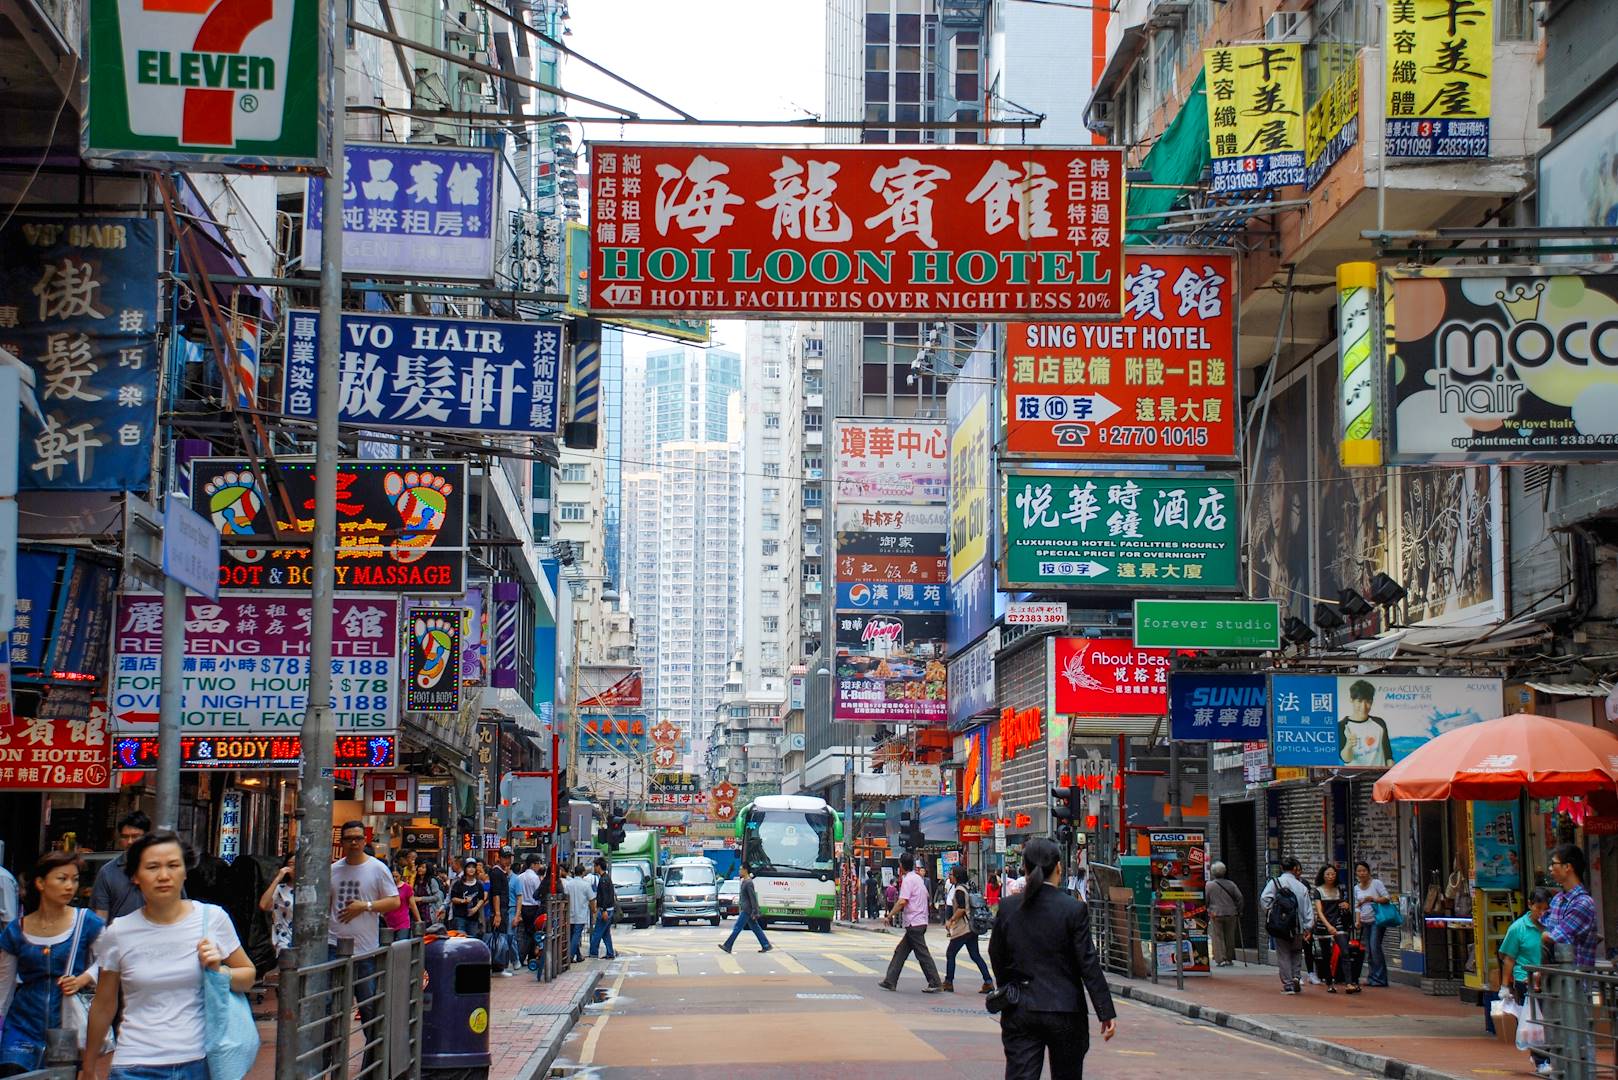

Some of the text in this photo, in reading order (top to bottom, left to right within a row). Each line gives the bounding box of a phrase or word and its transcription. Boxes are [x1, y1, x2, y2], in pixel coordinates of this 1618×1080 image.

[1391, 0, 1416, 116] 美容纖體
[1419, 0, 1488, 116] 卡美屋
[1211, 50, 1239, 155] 美容纖體
[1238, 47, 1300, 153] 卡美屋
[1437, 138, 1487, 155] 23833132
[1214, 168, 1305, 191] 65191099 23833132
[597, 153, 617, 244] 酒店設備
[621, 153, 641, 244] 純粹租房
[655, 154, 1059, 249] 海龍賓館
[1067, 158, 1087, 247] 全日特平
[1090, 158, 1111, 248] 時租過夜
[598, 247, 1111, 285] HOI LOON HOTEL
[651, 289, 729, 307] HOTEL
[733, 290, 862, 308] FACILITEIS
[868, 291, 930, 309] OVER
[935, 292, 1010, 309] NIGHT
[1022, 292, 1072, 309] LESS
[1078, 292, 1111, 309] 20%
[1124, 263, 1225, 321] 賓館
[347, 323, 504, 353] VO HAIR
[1026, 324, 1211, 350] SING YUET HOTEL
[290, 317, 316, 415] 專業染色
[1013, 355, 1226, 386] 酒店設備 附設一日遊
[118, 310, 144, 447] 技巧染色
[529, 330, 556, 428] 技術剪髮
[1438, 373, 1524, 413] hair
[1135, 397, 1222, 422] 遠景大廈
[1503, 419, 1575, 429] We love hair
[1161, 427, 1208, 446] 1015
[1451, 435, 1530, 448] appointment
[1532, 434, 1558, 446] call:
[1561, 434, 1594, 445] 2388
[1153, 487, 1226, 531] 酒店
[1016, 539, 1079, 547] LUXURIOUS
[1081, 540, 1117, 548] HOTEL
[1119, 541, 1179, 549] FACILITIES
[1083, 550, 1116, 558] PRICE
[1143, 551, 1206, 559] OVERNIGHT
[218, 565, 450, 585] OOT & BOY MASSAGE
[1117, 562, 1203, 579] 遠景大廈
[1019, 614, 1042, 622] 2383
[1143, 618, 1272, 630] forever studio
[862, 620, 902, 641] Neway
[120, 637, 260, 654] REENG
[1091, 651, 1133, 666] About
[183, 677, 236, 691] TWO
[251, 678, 332, 691] HOU
[341, 678, 388, 692] $78
[201, 695, 337, 709] NIGHTLES
[343, 695, 388, 710] 188
[413, 691, 429, 703] FOOT
[436, 691, 452, 703] BODY
[1277, 692, 1333, 713] 法國
[181, 711, 386, 727] OTEL FACTIES
[1277, 730, 1336, 743] FRANCE
[31, 749, 106, 763] HOTEL
[198, 741, 211, 758] &
[216, 741, 269, 758] BODY
[271, 740, 367, 758] MAGE
[1276, 745, 1311, 753] OPTICAL
[1152, 833, 1185, 841] CASIO
